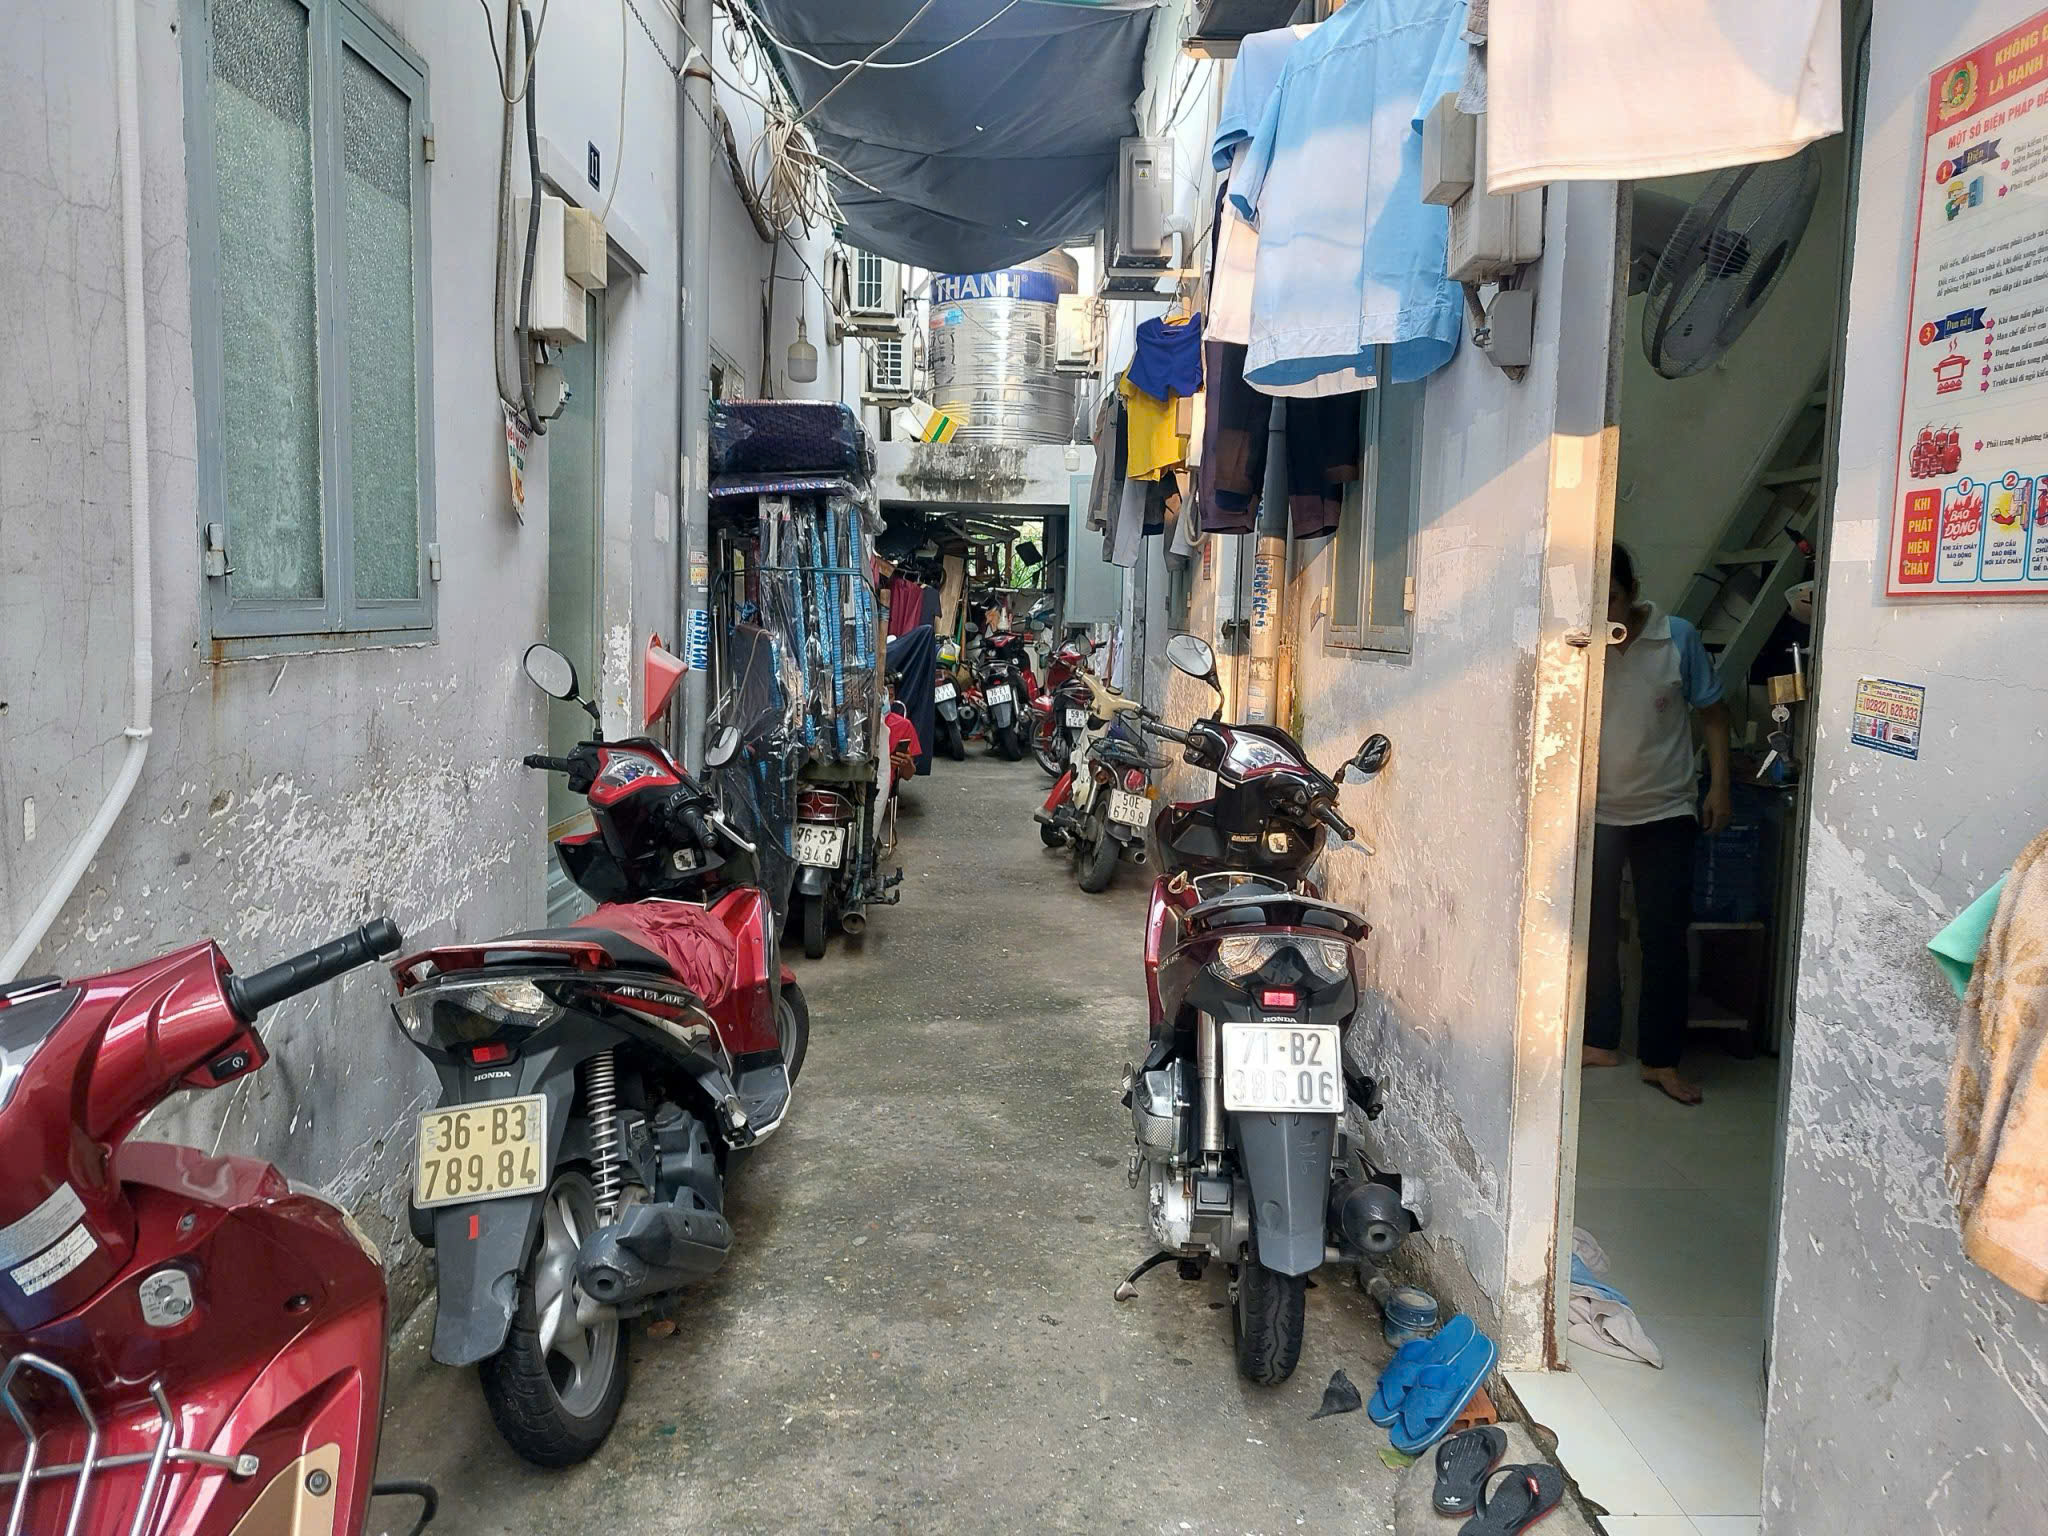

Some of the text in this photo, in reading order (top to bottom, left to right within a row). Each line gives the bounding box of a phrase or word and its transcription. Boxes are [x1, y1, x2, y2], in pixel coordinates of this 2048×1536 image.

[1961, 480, 1968, 492] 1
[2006, 475, 2016, 487] 2
[1914, 496, 1931, 511] KHI
[1908, 517, 1933, 533] PHÁT
[1907, 537, 1930, 557] HIỆN
[1113, 805, 1144, 824] 6798
[474, 1070, 512, 1082] HONDA
[436, 1104, 527, 1153] 36-B3
[424, 1146, 537, 1200] 789.84
